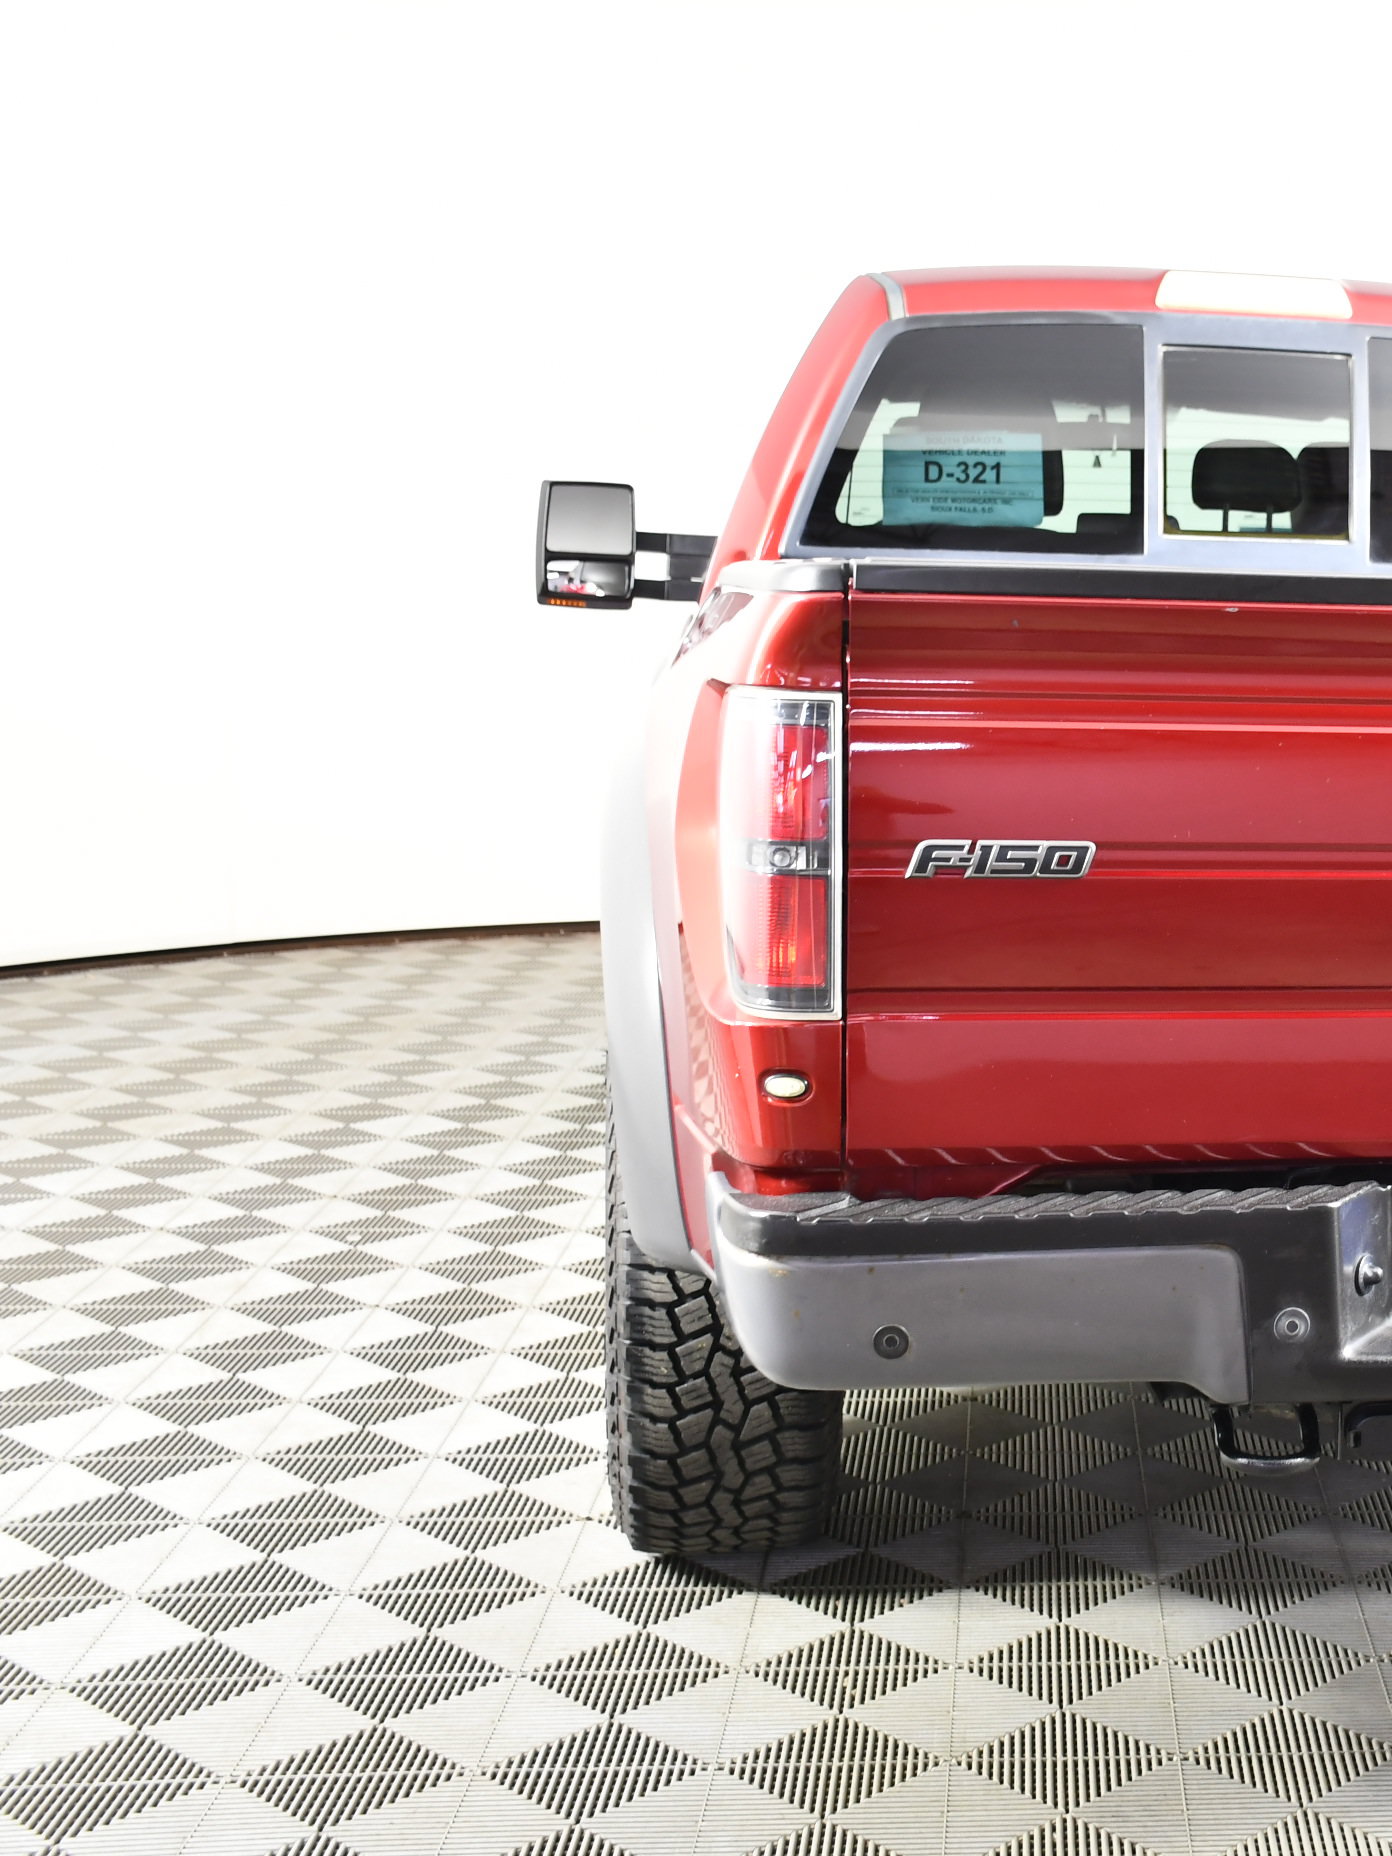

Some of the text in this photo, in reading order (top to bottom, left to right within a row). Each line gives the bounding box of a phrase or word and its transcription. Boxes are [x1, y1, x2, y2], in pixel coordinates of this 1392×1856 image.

[962, 435, 1004, 444] DAKOTA
[921, 448, 1006, 457] VEHICLE DEALER
[923, 461, 1002, 485] D-321
[904, 839, 1097, 879] F-150
